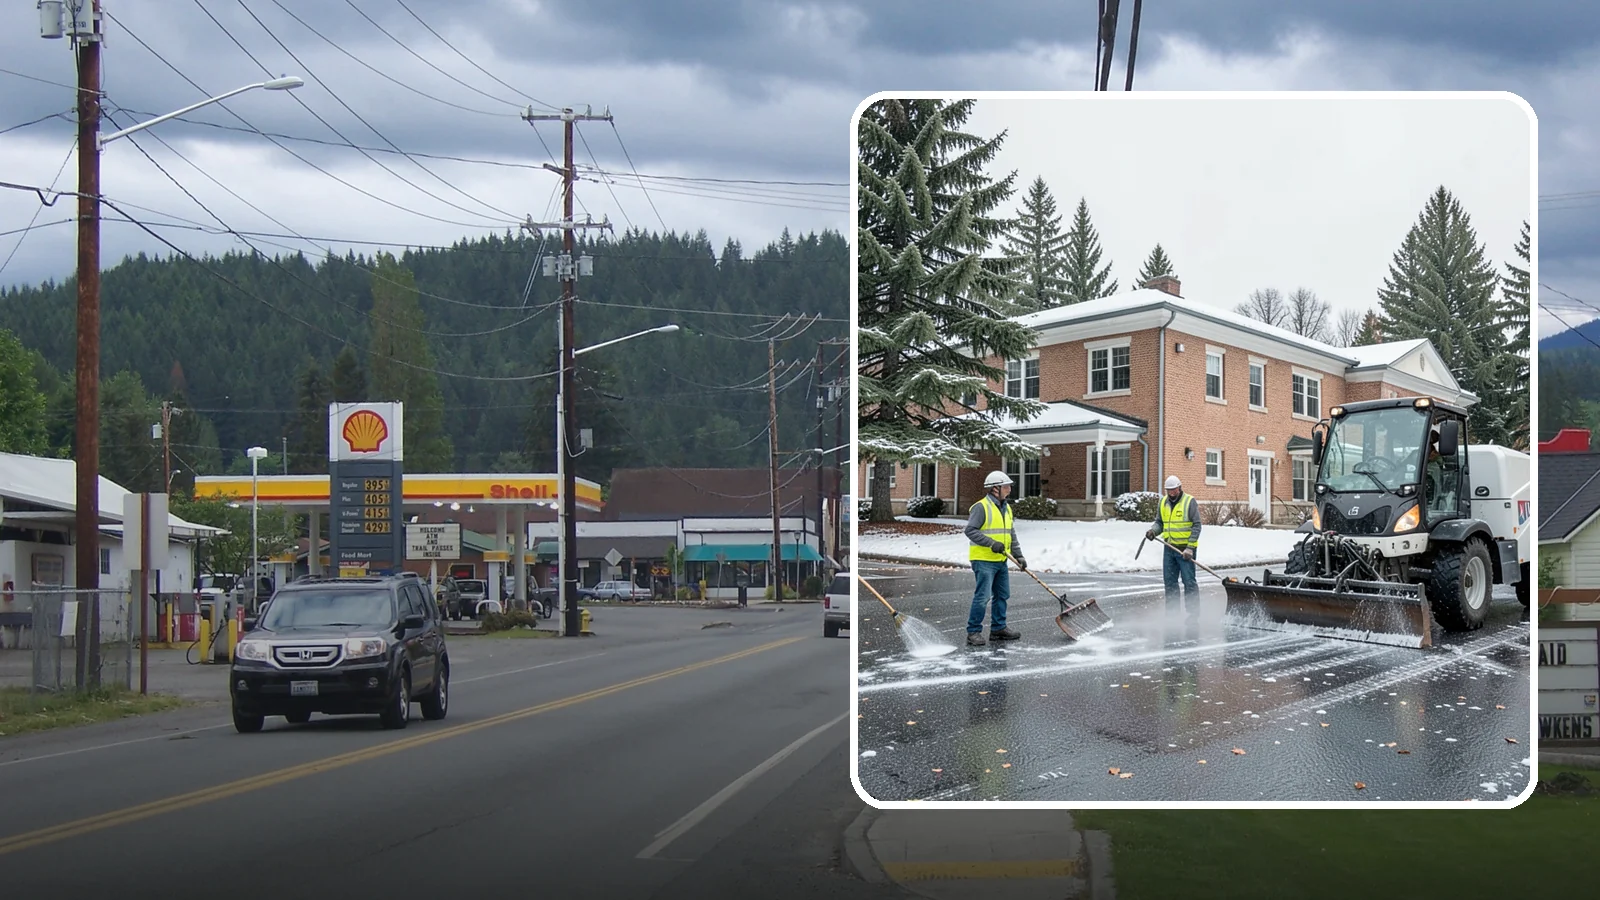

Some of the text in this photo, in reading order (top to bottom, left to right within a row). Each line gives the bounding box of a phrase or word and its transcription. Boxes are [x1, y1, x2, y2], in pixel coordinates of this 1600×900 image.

[366, 480, 384, 490] 395
[490, 484, 547, 499] Shell
[366, 494, 384, 504] 405
[366, 508, 383, 518] 415
[366, 522, 384, 533] 429
[1538, 643, 1567, 665] AID
